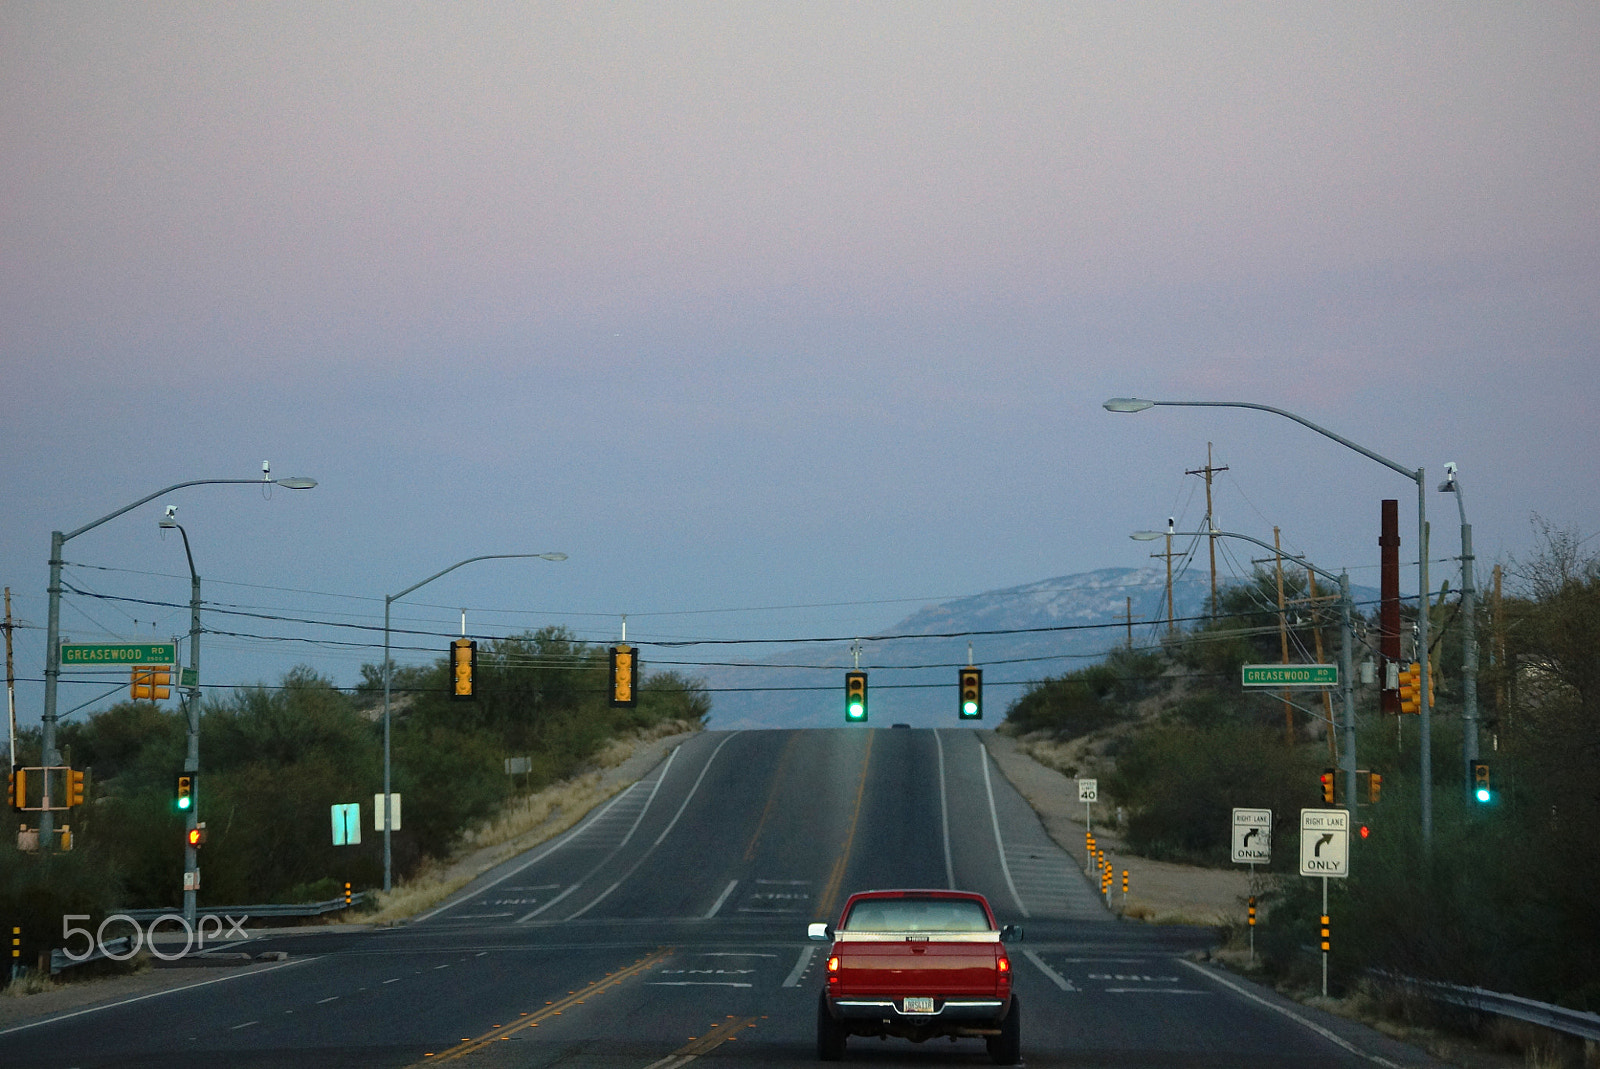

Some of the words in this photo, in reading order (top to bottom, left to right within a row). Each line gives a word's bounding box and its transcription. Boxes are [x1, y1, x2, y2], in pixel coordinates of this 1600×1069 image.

[67, 649, 142, 660] GREASEWOOD
[151, 647, 164, 655] RD
[1248, 671, 1310, 680] GREASEWOOD
[1081, 791, 1096, 799] 40
[1305, 817, 1324, 826] RIGHT
[1327, 818, 1344, 826] LANE
[1238, 849, 1266, 858] ONLY
[1307, 860, 1340, 870] ONLY
